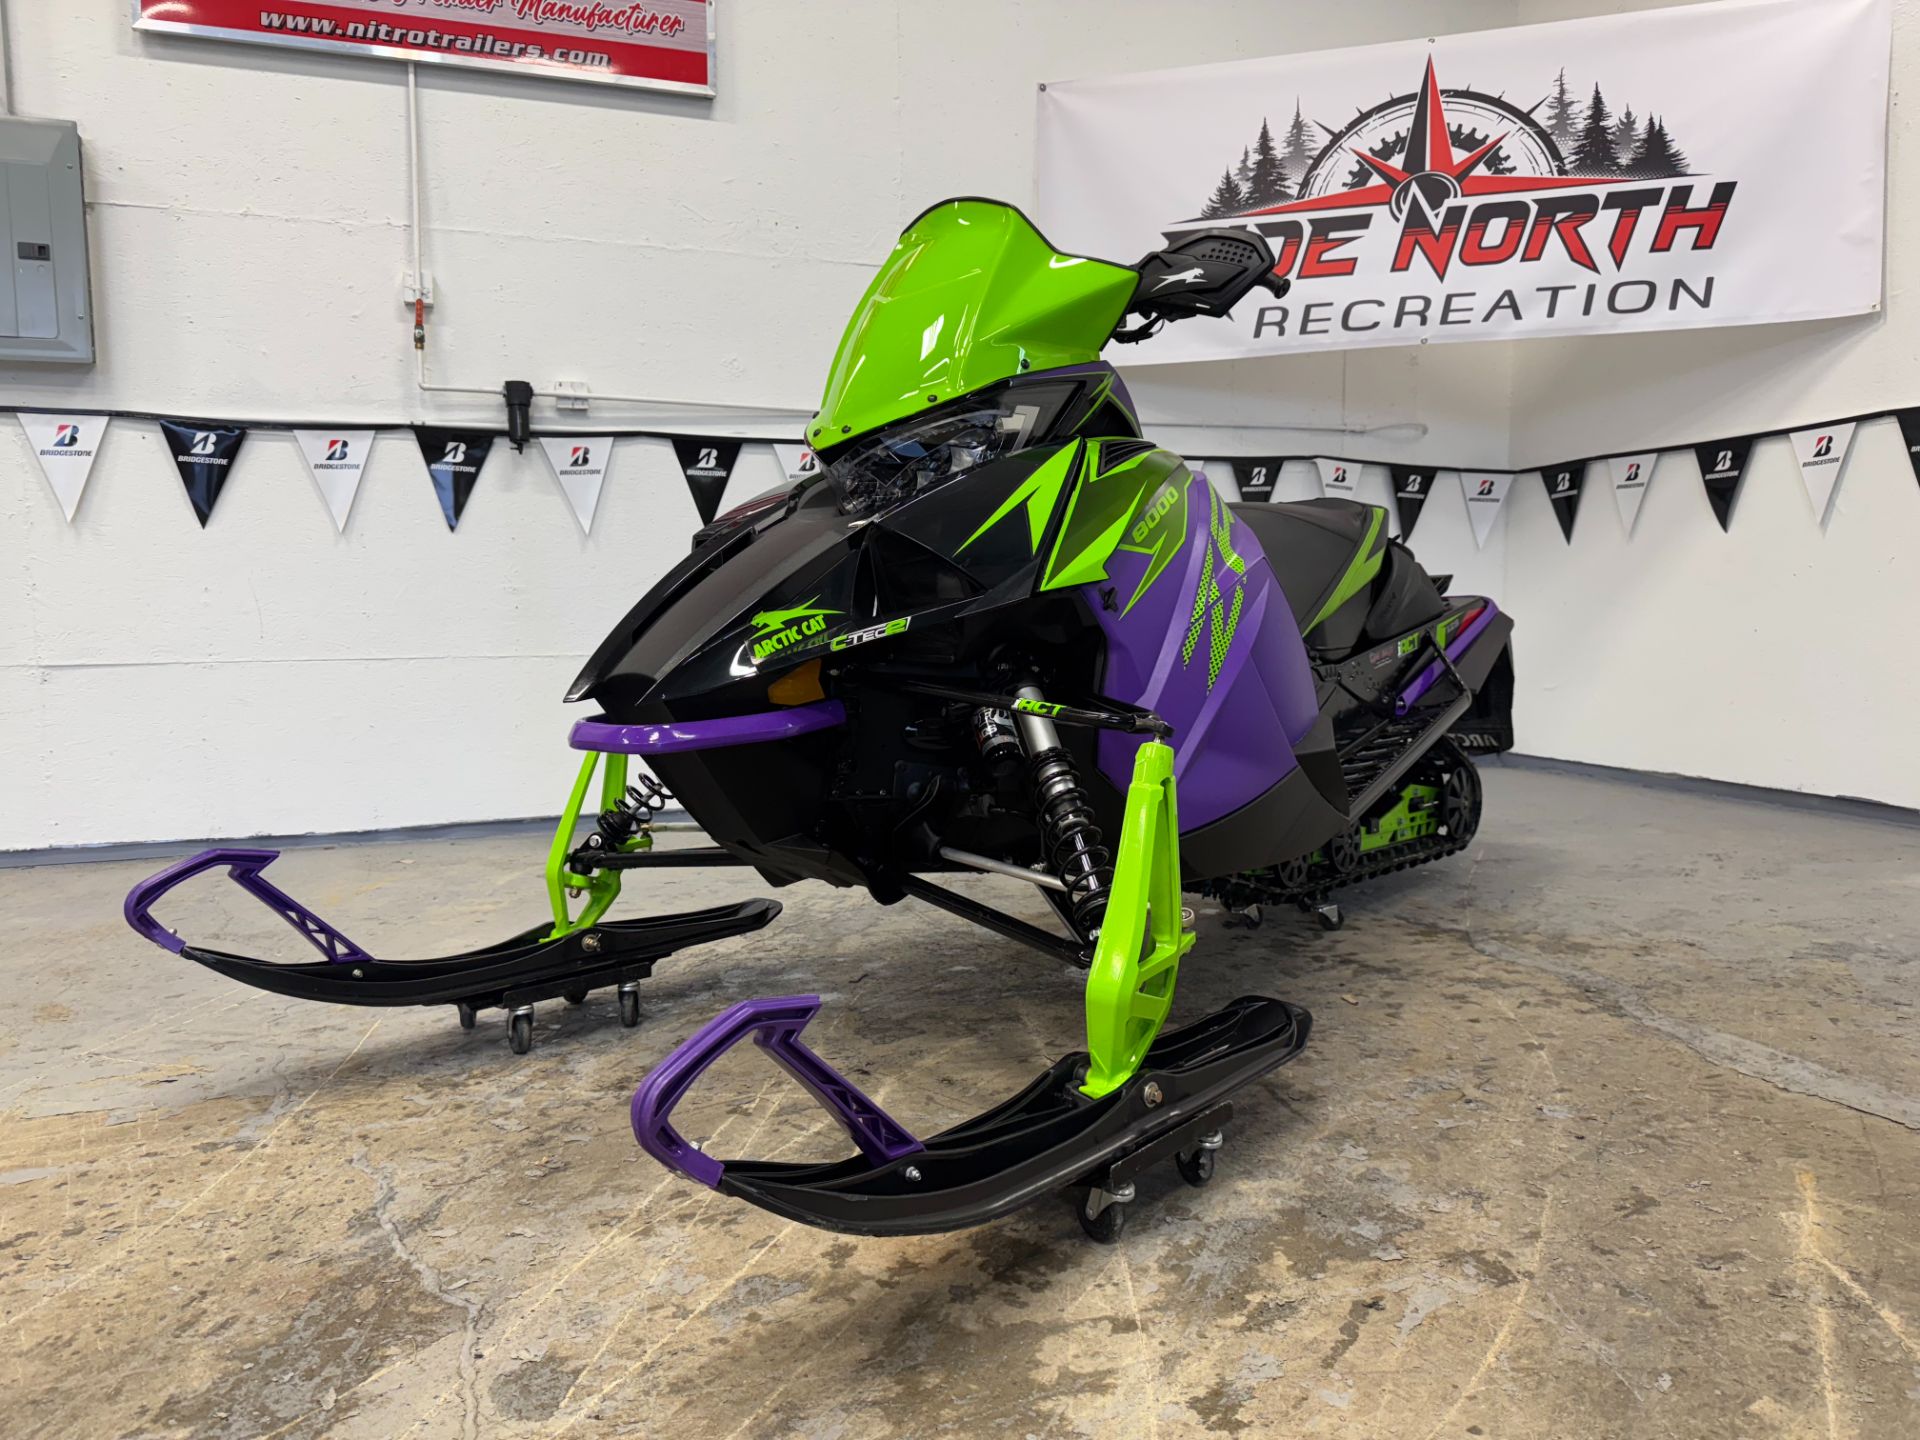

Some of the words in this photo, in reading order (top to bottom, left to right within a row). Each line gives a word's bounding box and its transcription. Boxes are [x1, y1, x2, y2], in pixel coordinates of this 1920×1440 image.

[512, 0, 685, 36] Manufacturer
[259, 11, 612, 67] www.nitrotrailers.com
[1389, 181, 1738, 283] NORTH
[1253, 276, 1715, 339] RECREATION
[40, 449, 92, 457] BRIDGESTONE
[178, 455, 229, 466] BRIDGESTONE
[430, 463, 477, 473] BRIDGESTONE
[1802, 456, 1841, 467] BRIDGESTONE
[687, 469, 727, 477] BRIDGESTONE
[1132, 486, 1179, 544] 8000
[753, 625, 803, 659] ARCTIC
[801, 614, 827, 636] CAT
